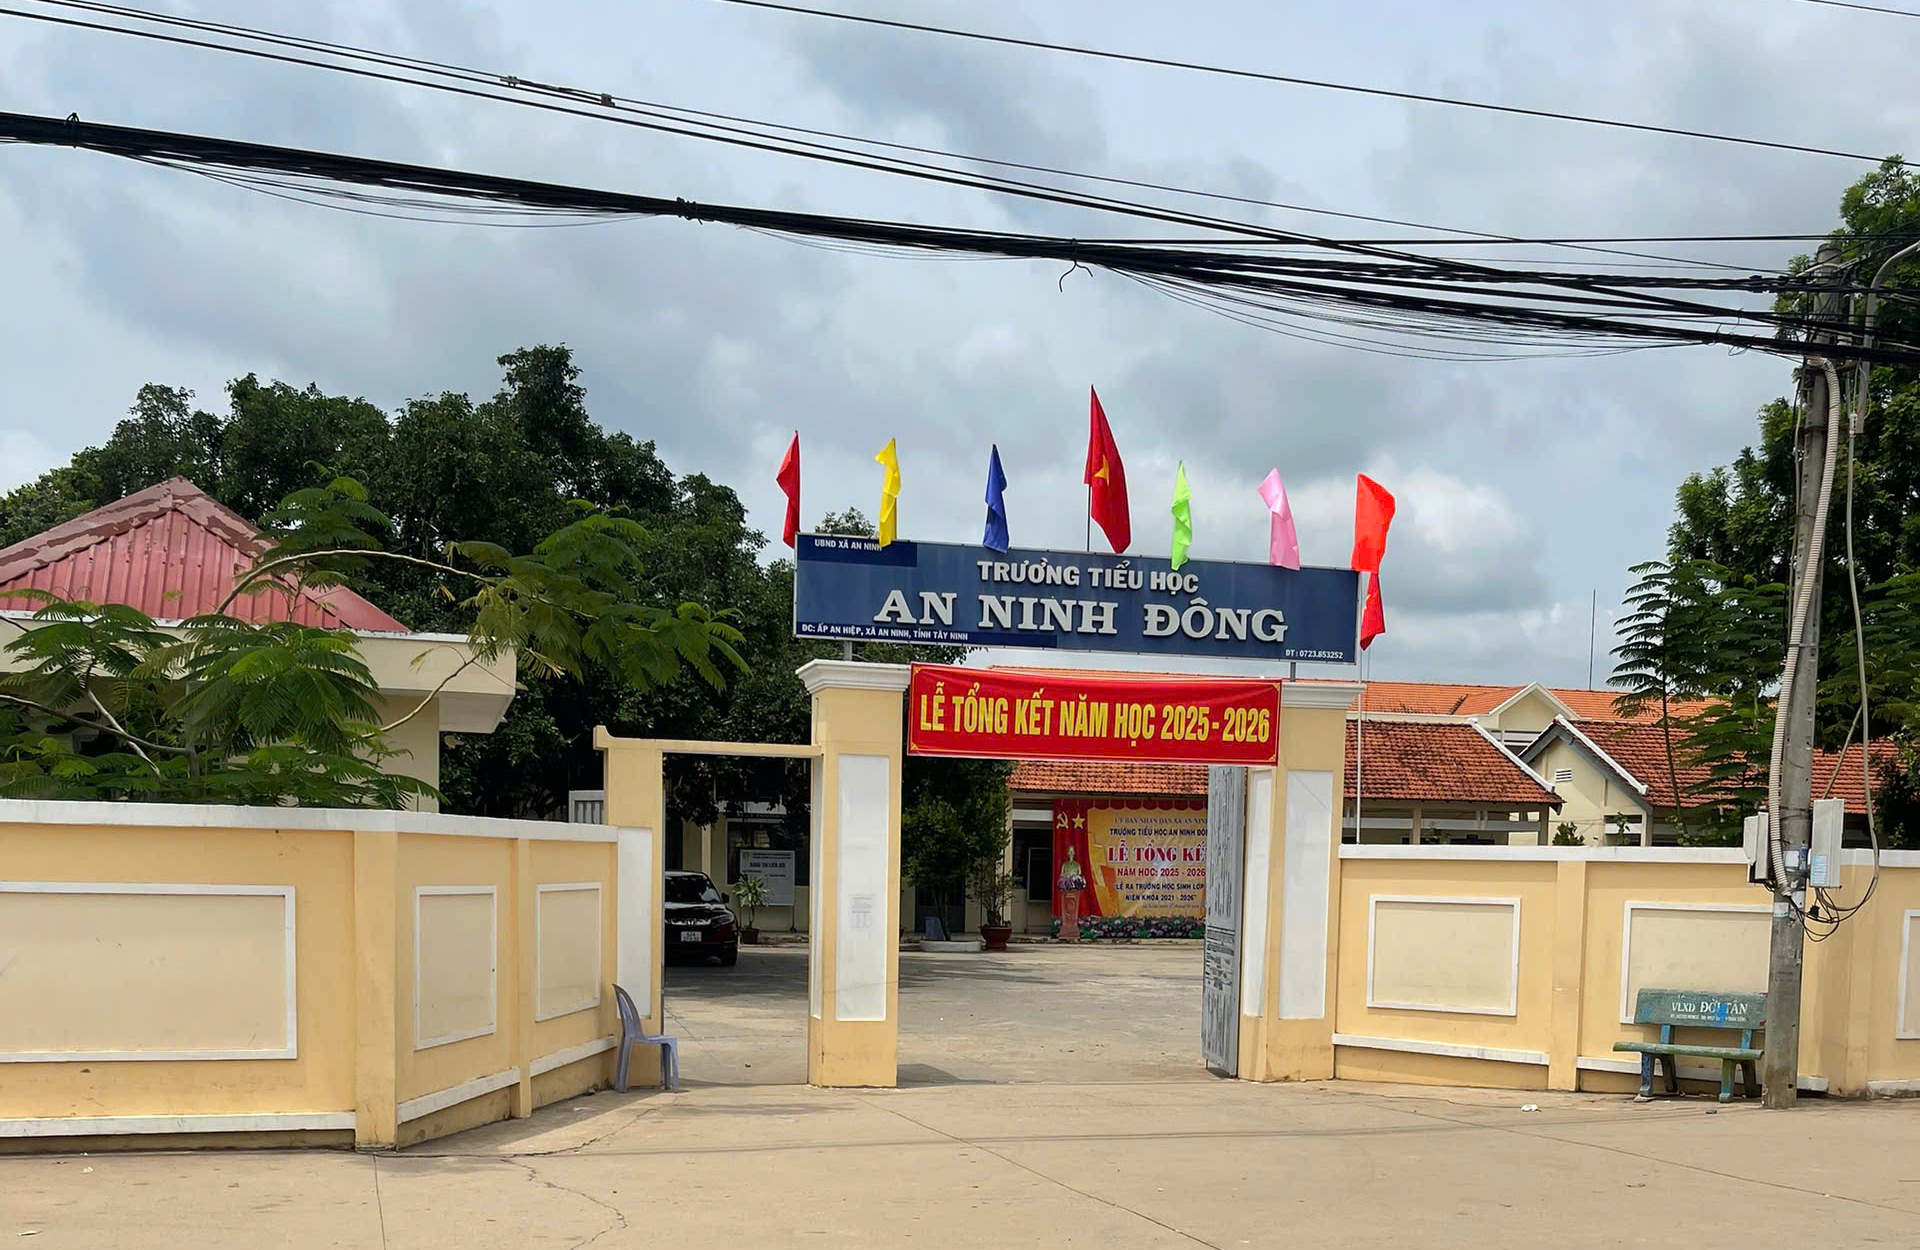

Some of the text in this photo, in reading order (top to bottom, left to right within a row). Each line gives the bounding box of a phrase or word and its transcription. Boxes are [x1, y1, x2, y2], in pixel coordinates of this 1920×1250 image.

[814, 538, 837, 548] UBND
[838, 539, 850, 549] XÃ
[977, 557, 1199, 595] TRƯỜNG TIỂU HỌC
[873, 589, 1288, 642] AN NINH ĐÔNG
[817, 622, 829, 633] ẤP
[830, 625, 842, 634] AN
[843, 626, 864, 636] HIỆP,
[865, 625, 876, 636] XÃ
[877, 628, 889, 637] AN
[890, 629, 911, 639] NINH,
[913, 627, 931, 639] TỈNH
[933, 629, 949, 640] TÂY
[950, 632, 969, 641] NINH
[1299, 650, 1344, 659] 0723.853252
[920, 682, 945, 732] LỄ
[952, 682, 1008, 735] TỔNG
[1015, 688, 1054, 736] KẾT
[1059, 693, 1108, 738] NĂM
[1114, 702, 1155, 747] HỌC
[1179, 828, 1195, 836] NINH
[1107, 839, 1208, 862] LỄ TỔNG KẾ
[1117, 867, 1136, 877] NĂM
[1160, 868, 1180, 877] 2025
[1186, 868, 1206, 877] 2026
[1161, 883, 1175, 891] HỌC
[1671, 1002, 1696, 1013] VLXD
